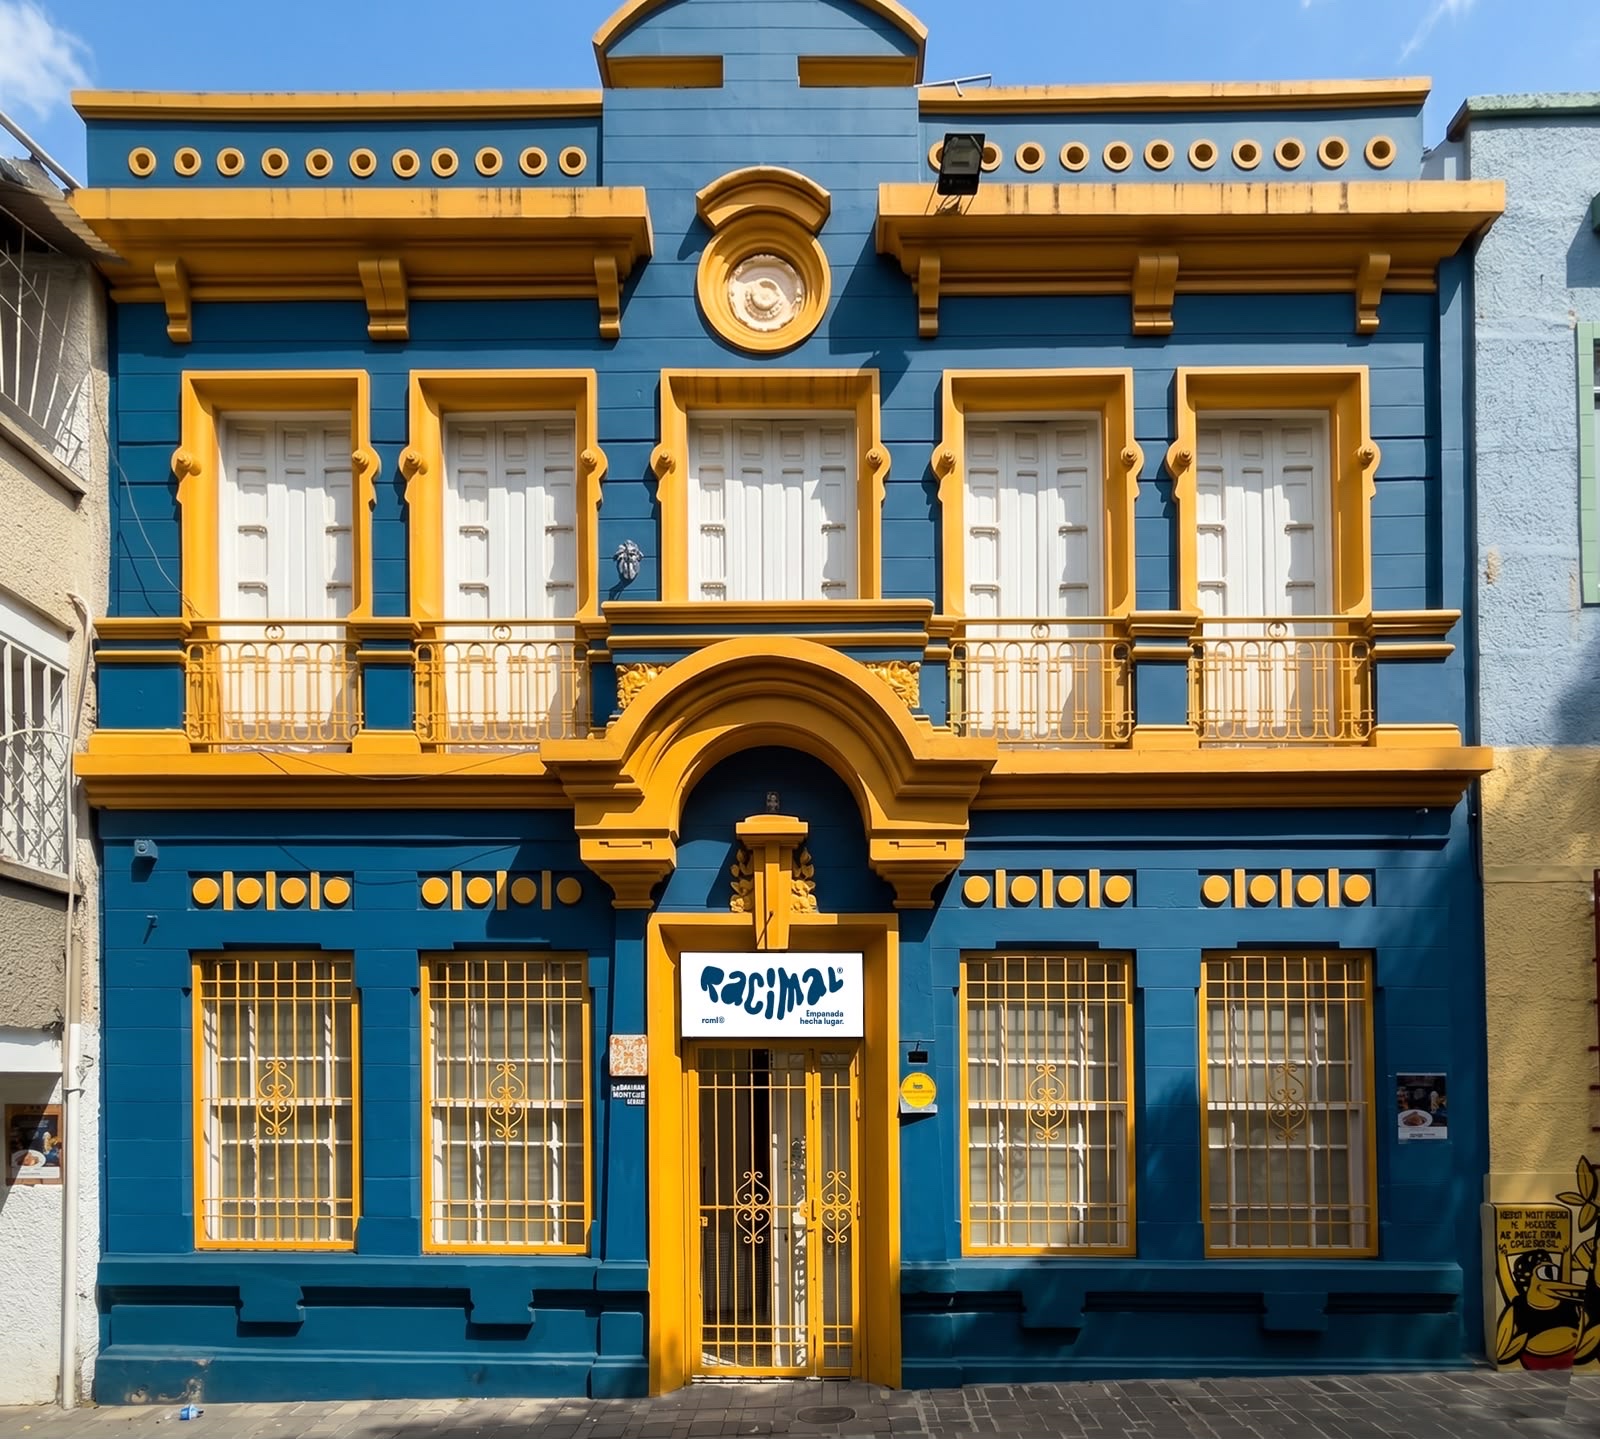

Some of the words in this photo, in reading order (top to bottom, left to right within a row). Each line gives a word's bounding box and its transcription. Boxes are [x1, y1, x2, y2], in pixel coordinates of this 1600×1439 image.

[806, 1010, 844, 1019] Empanada
[800, 1017, 822, 1025] hecha
[824, 1017, 844, 1027] lugar.
